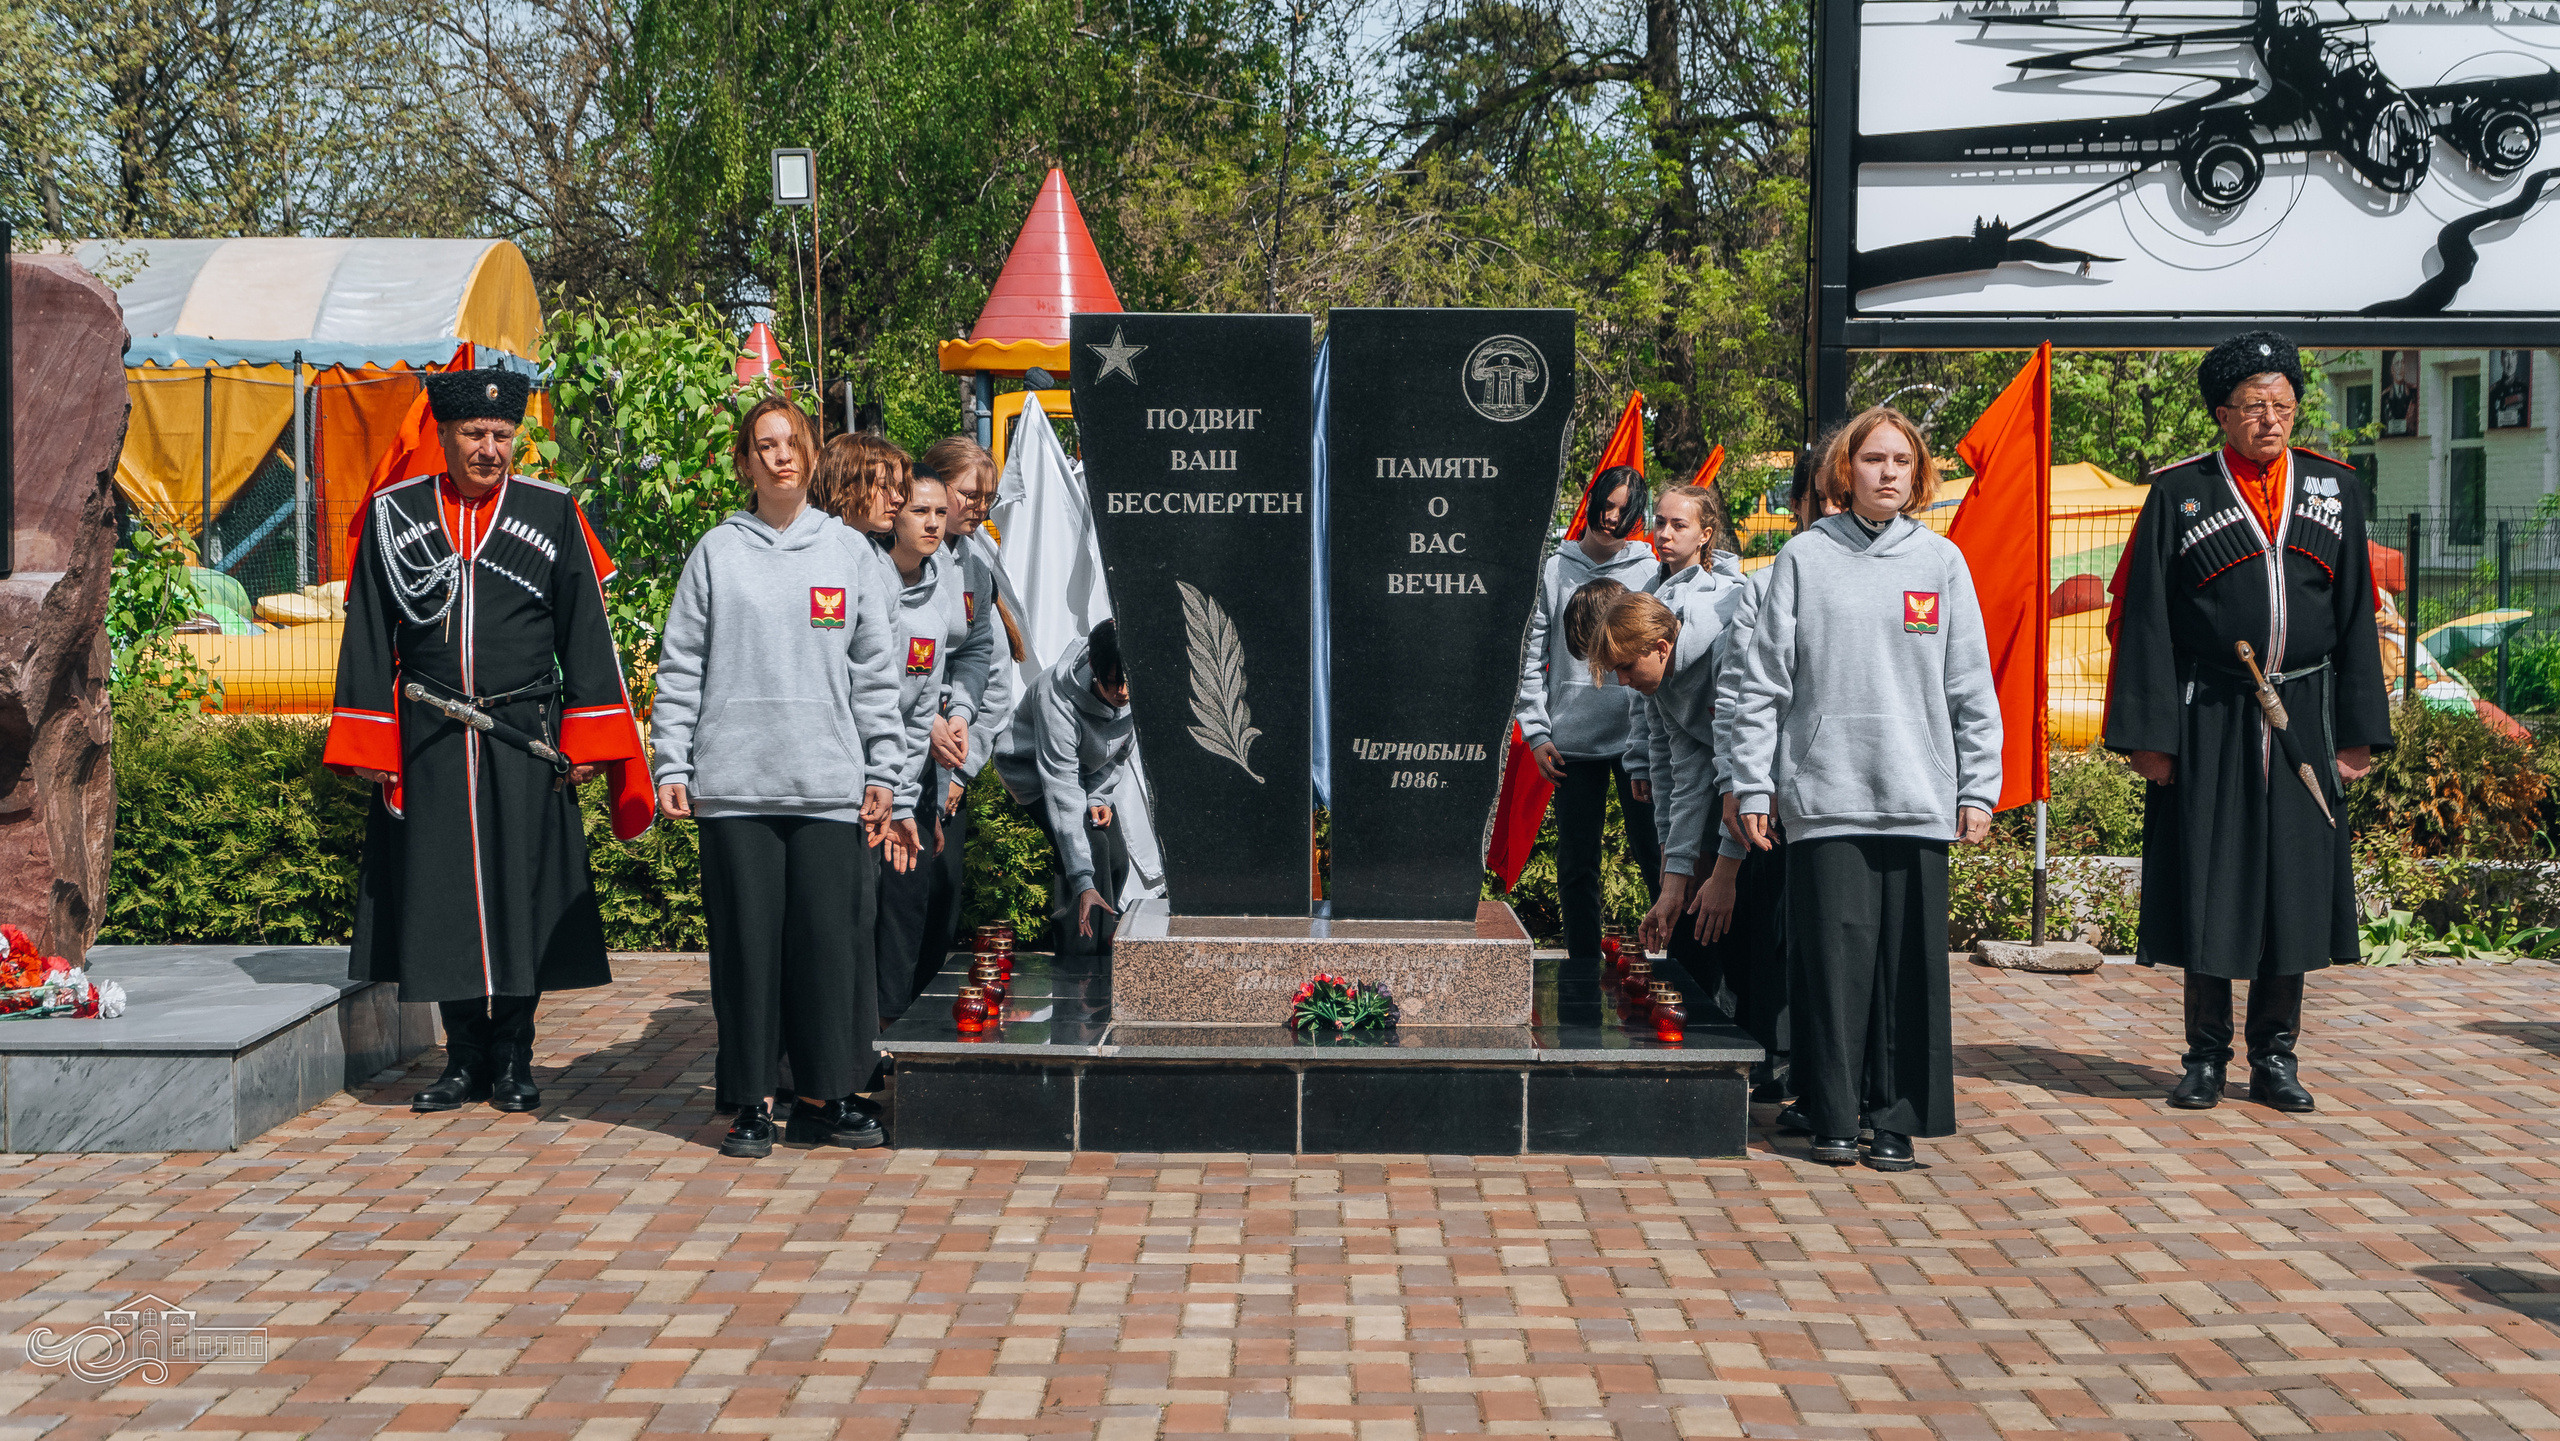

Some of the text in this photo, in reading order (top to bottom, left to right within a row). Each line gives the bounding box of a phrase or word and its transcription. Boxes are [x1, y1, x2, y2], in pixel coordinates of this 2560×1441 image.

[1146, 408, 1262, 433] ПОДВИГ
[1170, 449, 1238, 471] ВАШ
[1375, 457, 1499, 479] ПАМЯТЬ
[1106, 492, 1304, 514] БЕССМЕРТЕН
[1427, 496, 1450, 518] О
[1408, 532, 1467, 554] ВАС
[1387, 573, 1488, 595] ВЕЧНА
[1352, 738, 1487, 761] ЧЕРНОБЫЛЬ
[1390, 770, 1439, 789] 1986
